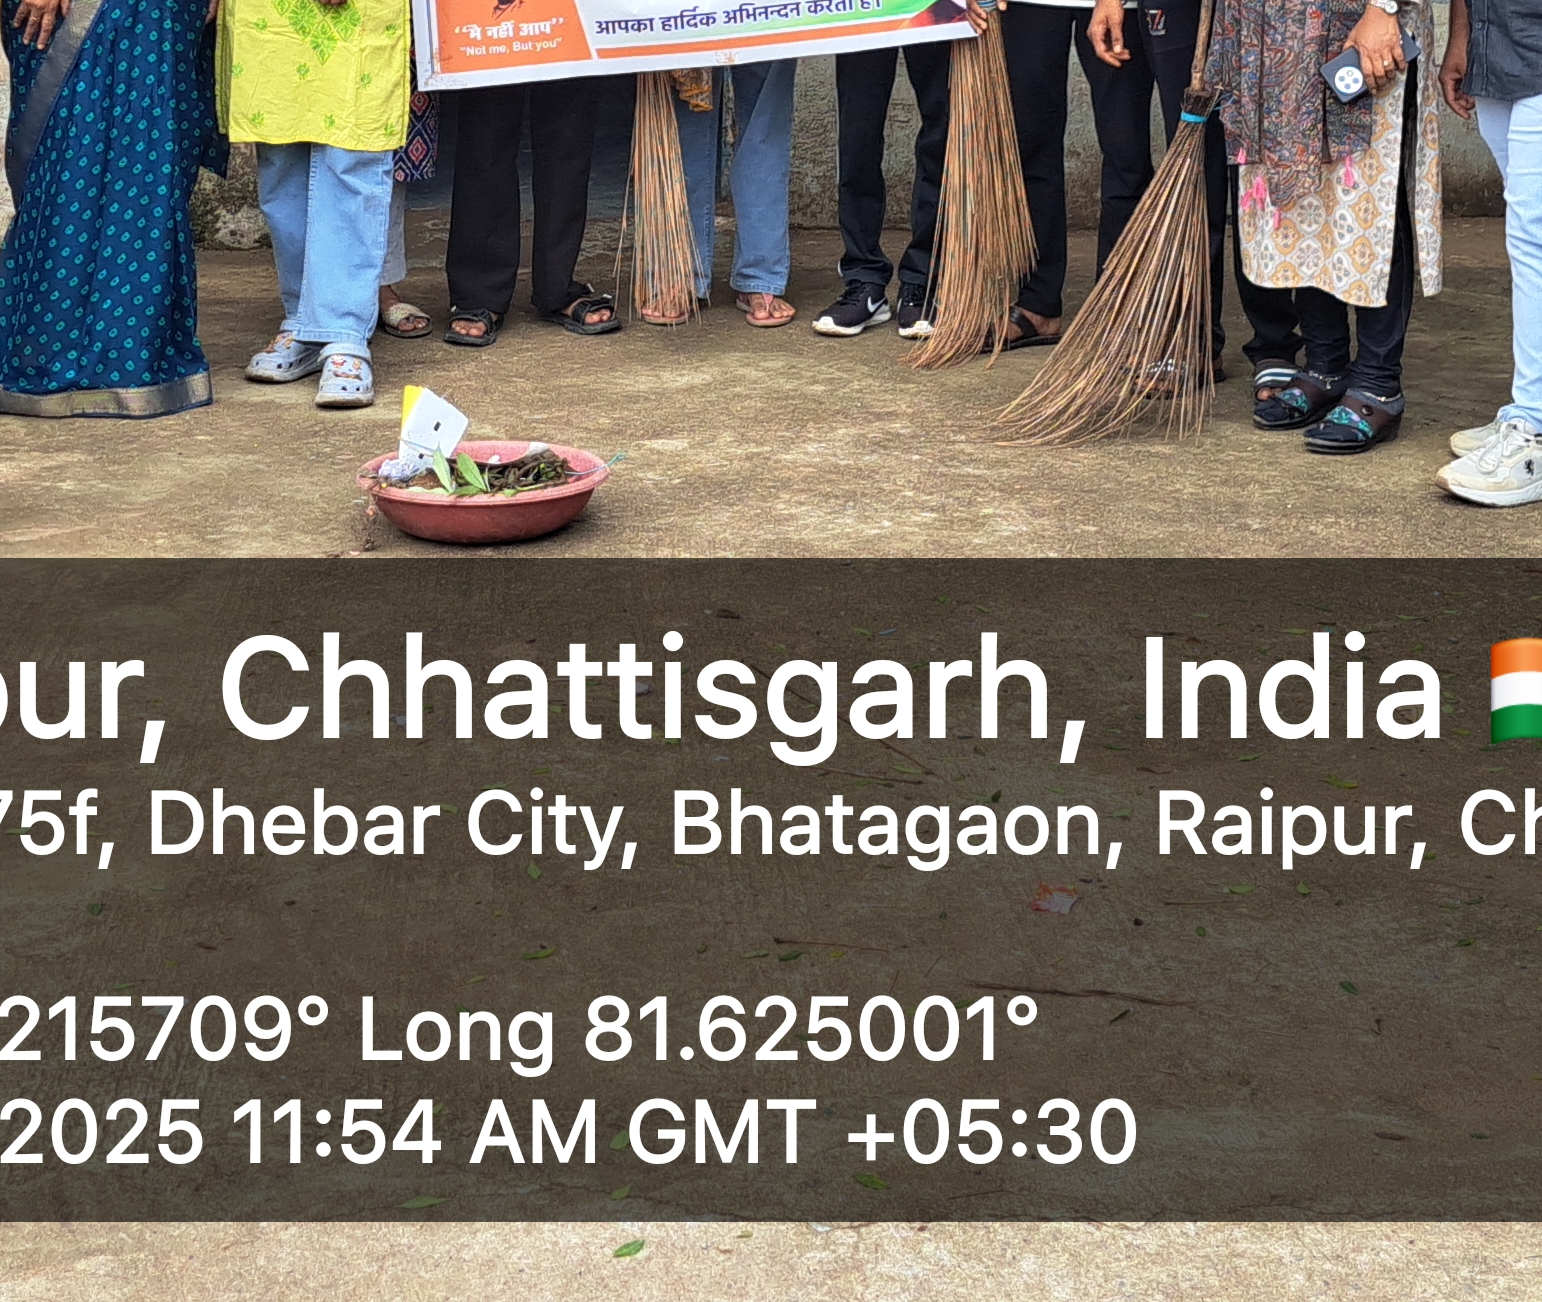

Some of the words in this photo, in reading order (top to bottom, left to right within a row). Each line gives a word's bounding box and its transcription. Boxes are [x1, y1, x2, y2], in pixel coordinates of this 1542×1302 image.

[595, 16, 654, 36] आपका
[659, 6, 717, 32] हार्दिक
[722, 1, 801, 26] अभिनन्दन
